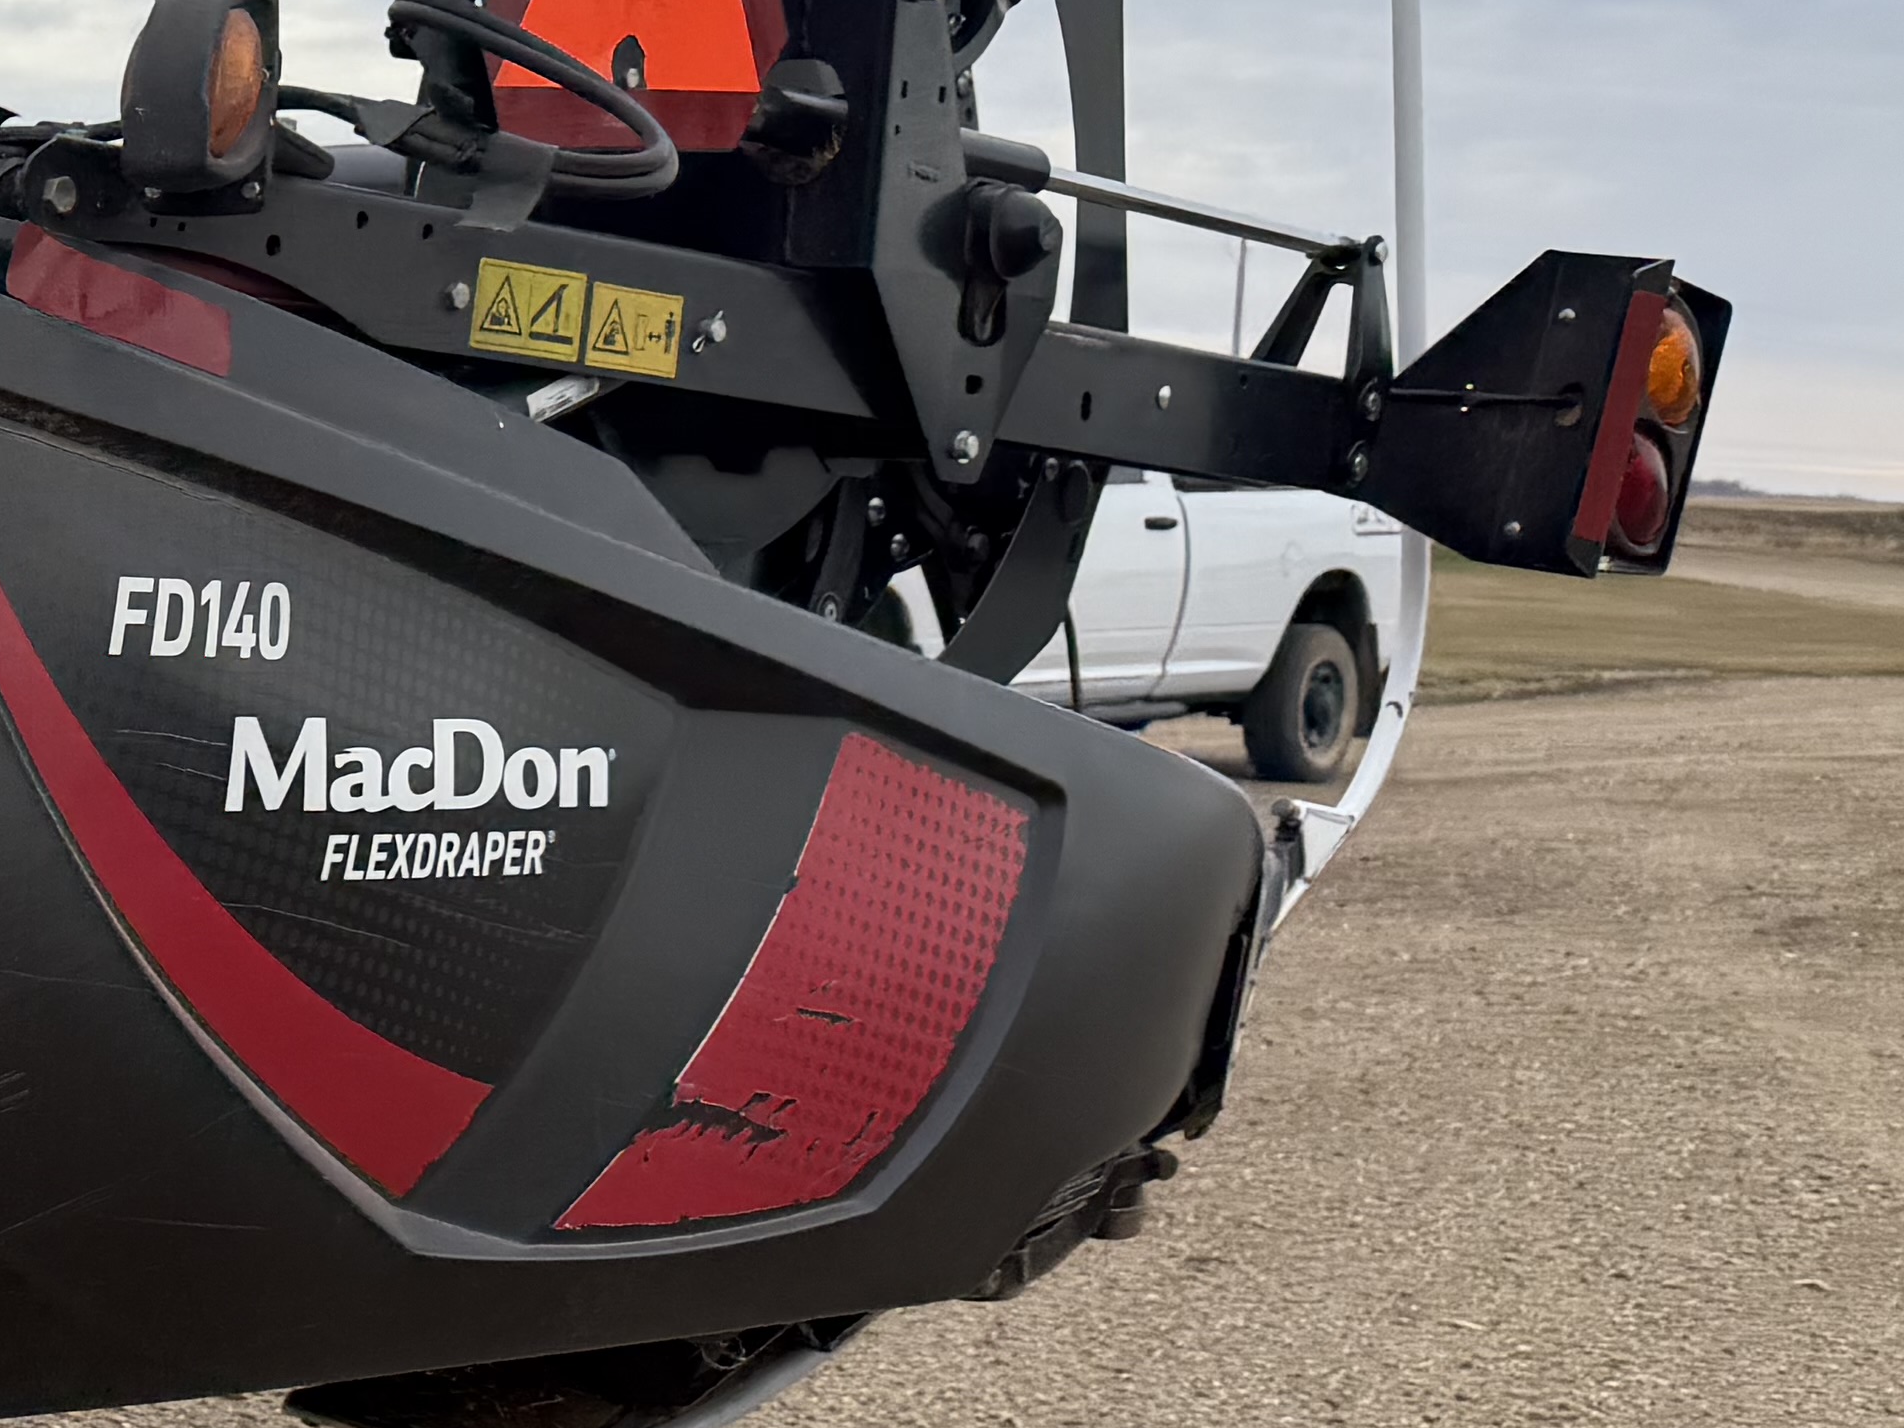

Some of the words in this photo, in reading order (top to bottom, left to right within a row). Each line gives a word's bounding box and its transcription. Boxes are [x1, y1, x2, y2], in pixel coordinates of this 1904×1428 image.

[108, 576, 291, 661] FD140
[224, 716, 609, 813] MacDon
[320, 830, 547, 882] FLEXDRAPER
